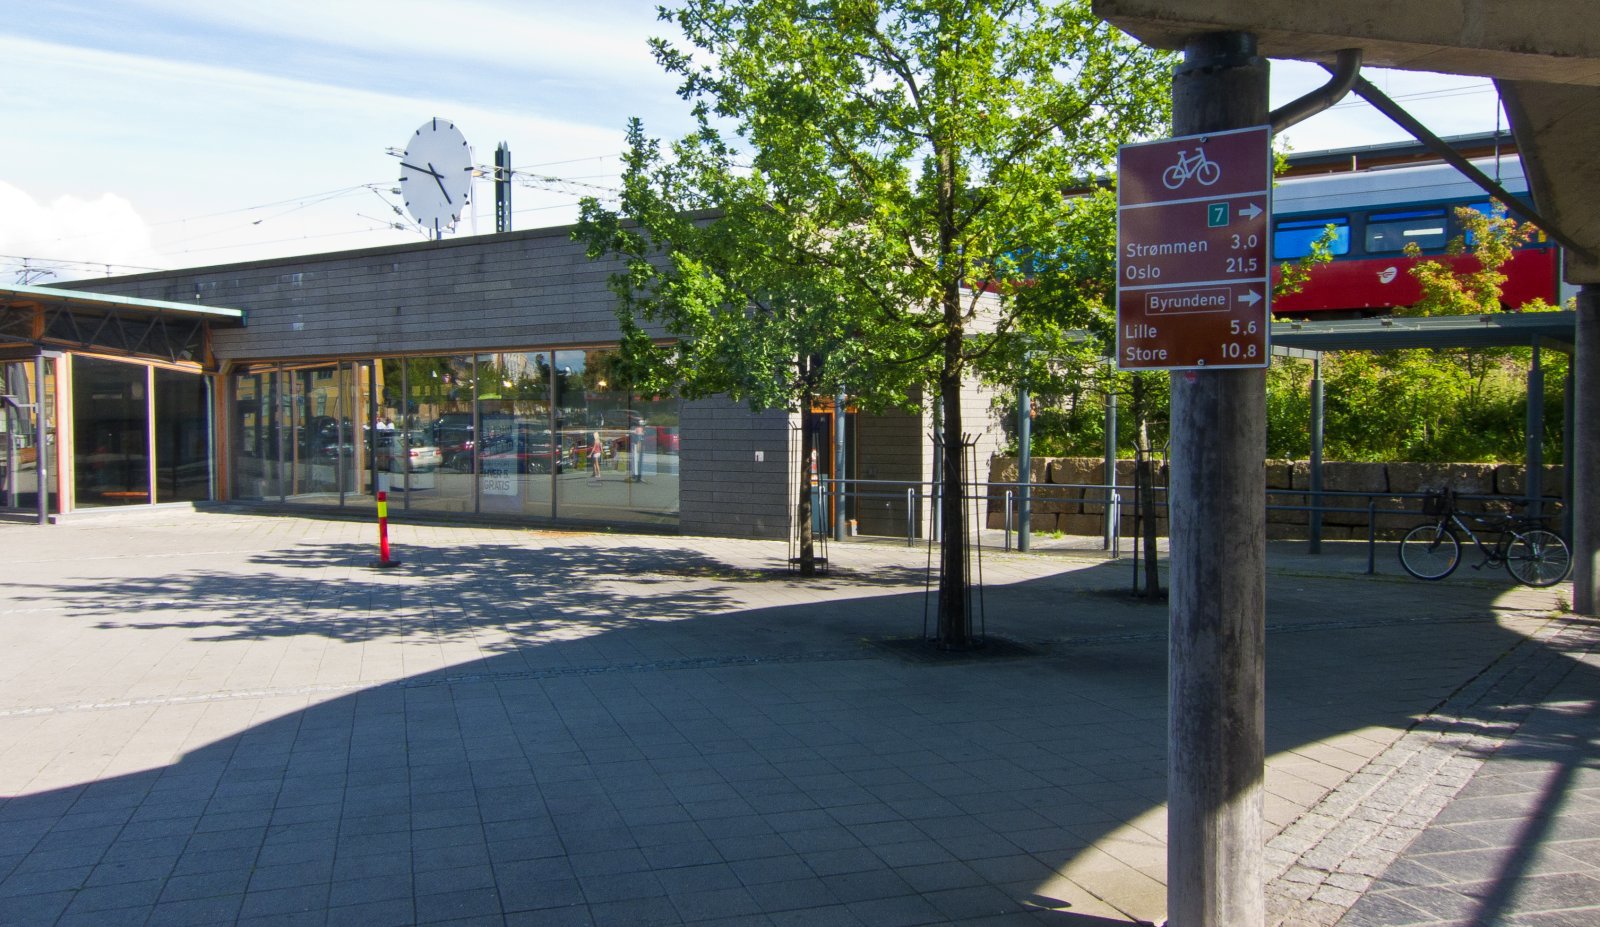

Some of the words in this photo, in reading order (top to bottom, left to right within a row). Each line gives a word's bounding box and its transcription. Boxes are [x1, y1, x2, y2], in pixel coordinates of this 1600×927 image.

[1214, 207, 1224, 223] 7
[1126, 239, 1208, 257] Strømmen
[1231, 234, 1258, 250] 3,0
[1126, 264, 1161, 280] Oslo
[1226, 257, 1258, 274] 21,5
[1150, 292, 1226, 311] Byrundene
[1125, 324, 1158, 339] Lille
[1230, 320, 1257, 336] 5,6
[1125, 347, 1168, 361] Store
[1221, 343, 1257, 359] 10,8
[484, 480, 510, 491] GRATIS
